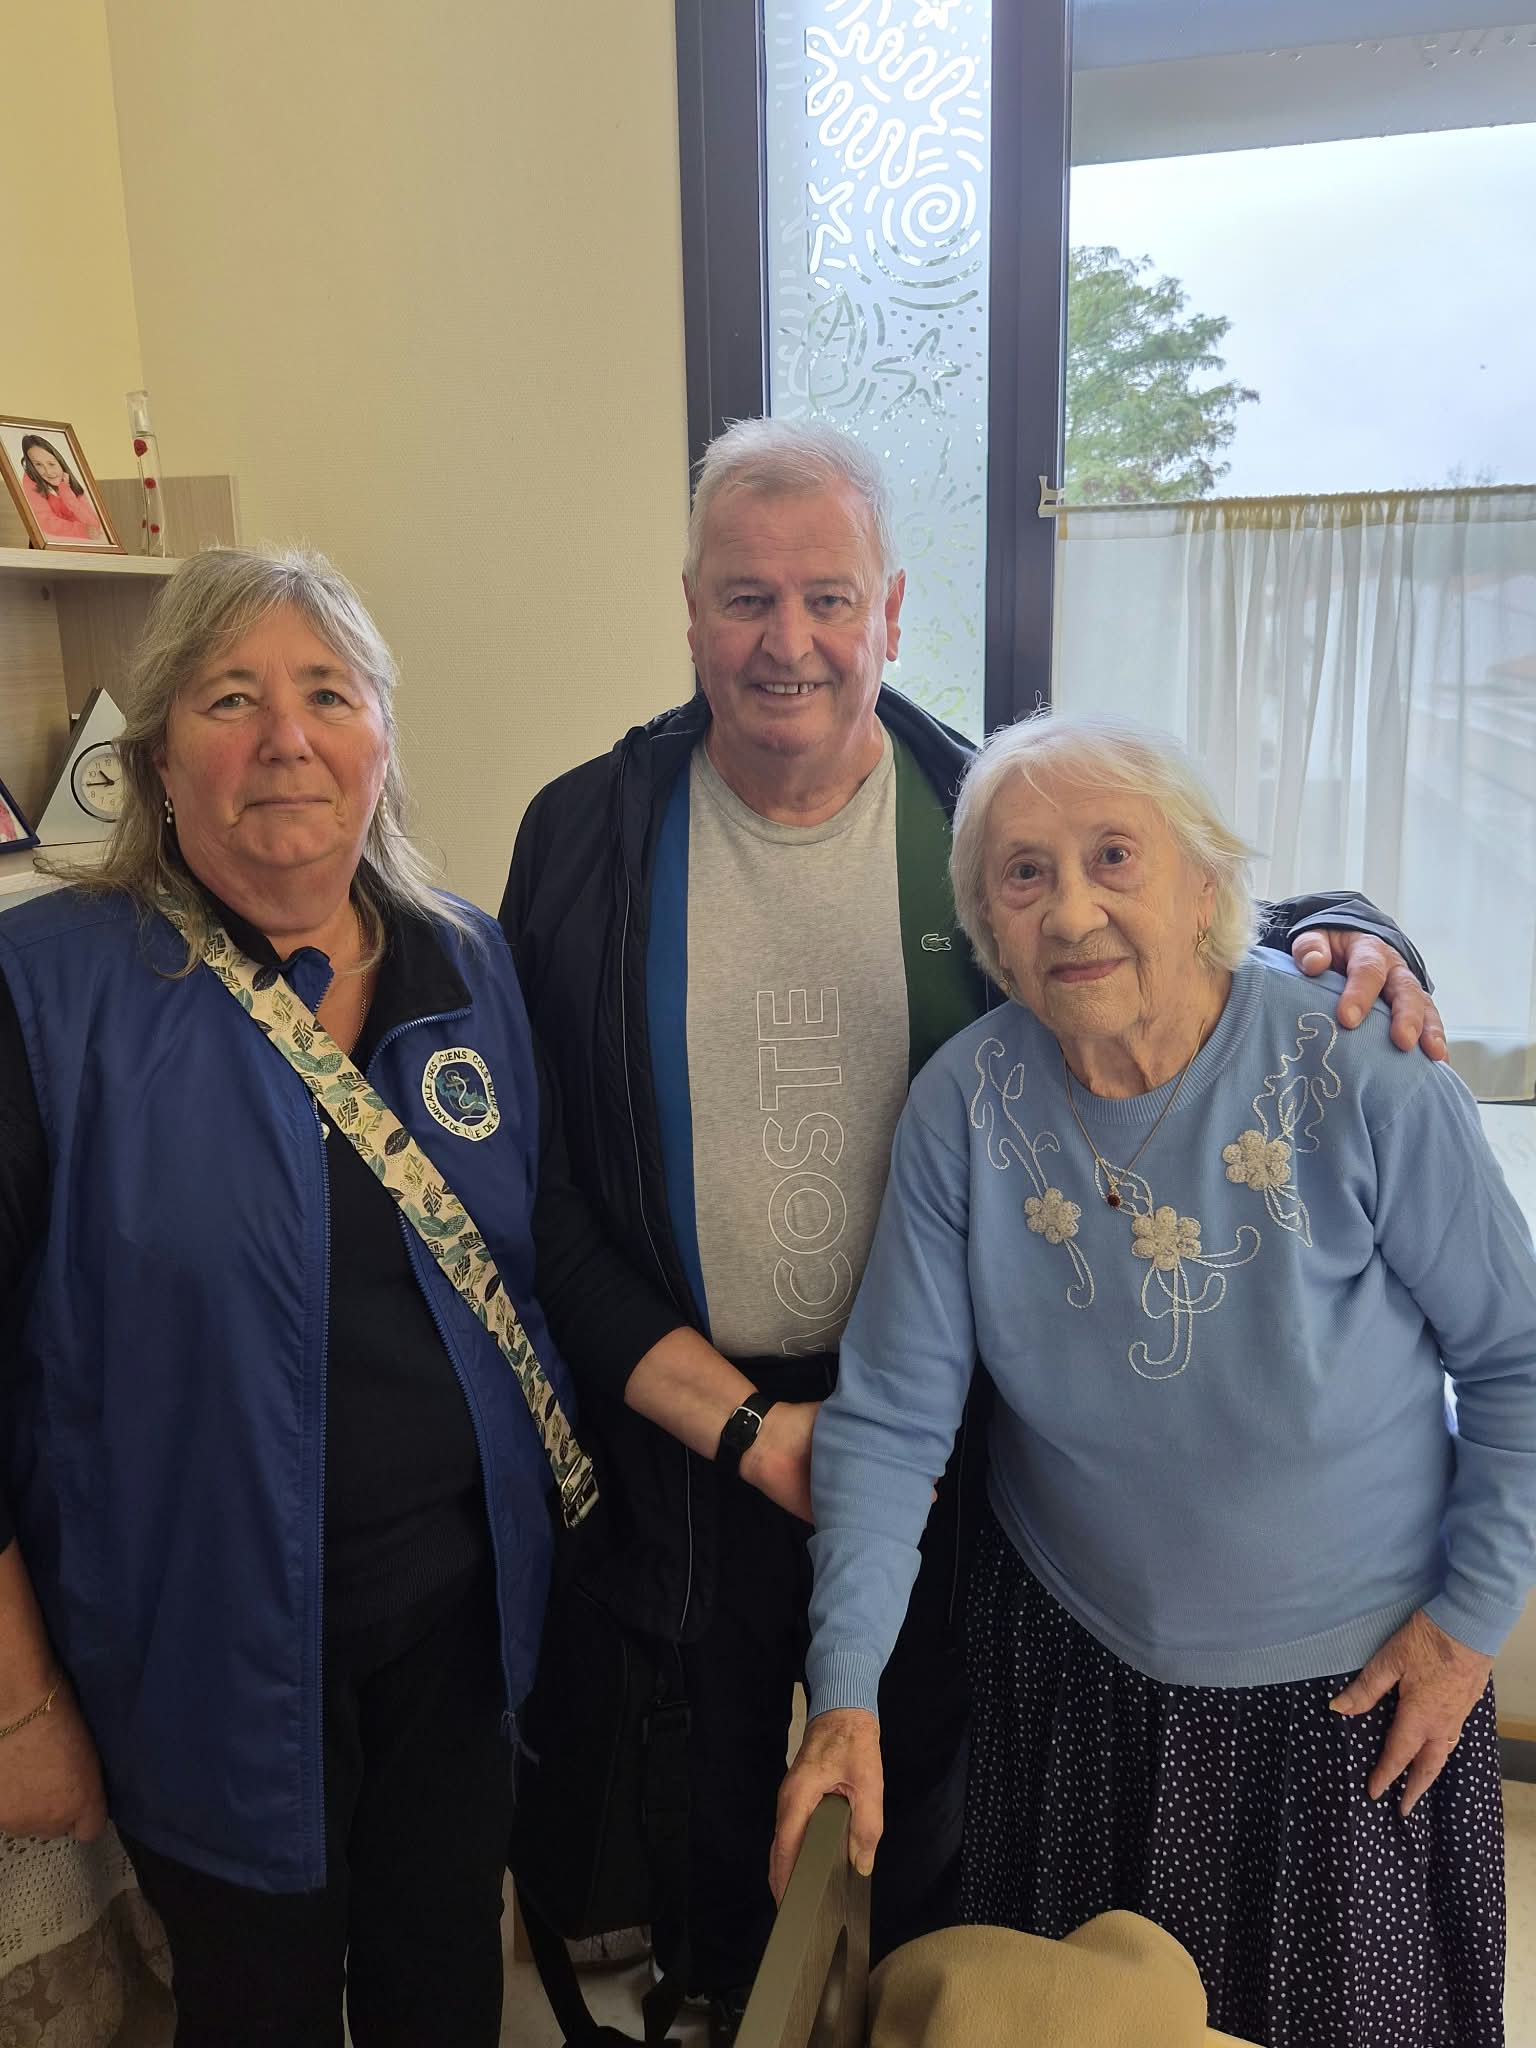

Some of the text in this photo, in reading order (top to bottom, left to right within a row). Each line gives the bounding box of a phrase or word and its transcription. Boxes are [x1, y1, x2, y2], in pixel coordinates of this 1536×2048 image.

[105, 758, 112, 767] 12
[88, 770, 97, 778] 10
[90, 790, 96, 799] 8
[427, 1061, 438, 1080] DES
[424, 1083, 449, 1125] AMICALE
[449, 1123, 461, 1134] DE
[482, 1120, 496, 1134] DE
